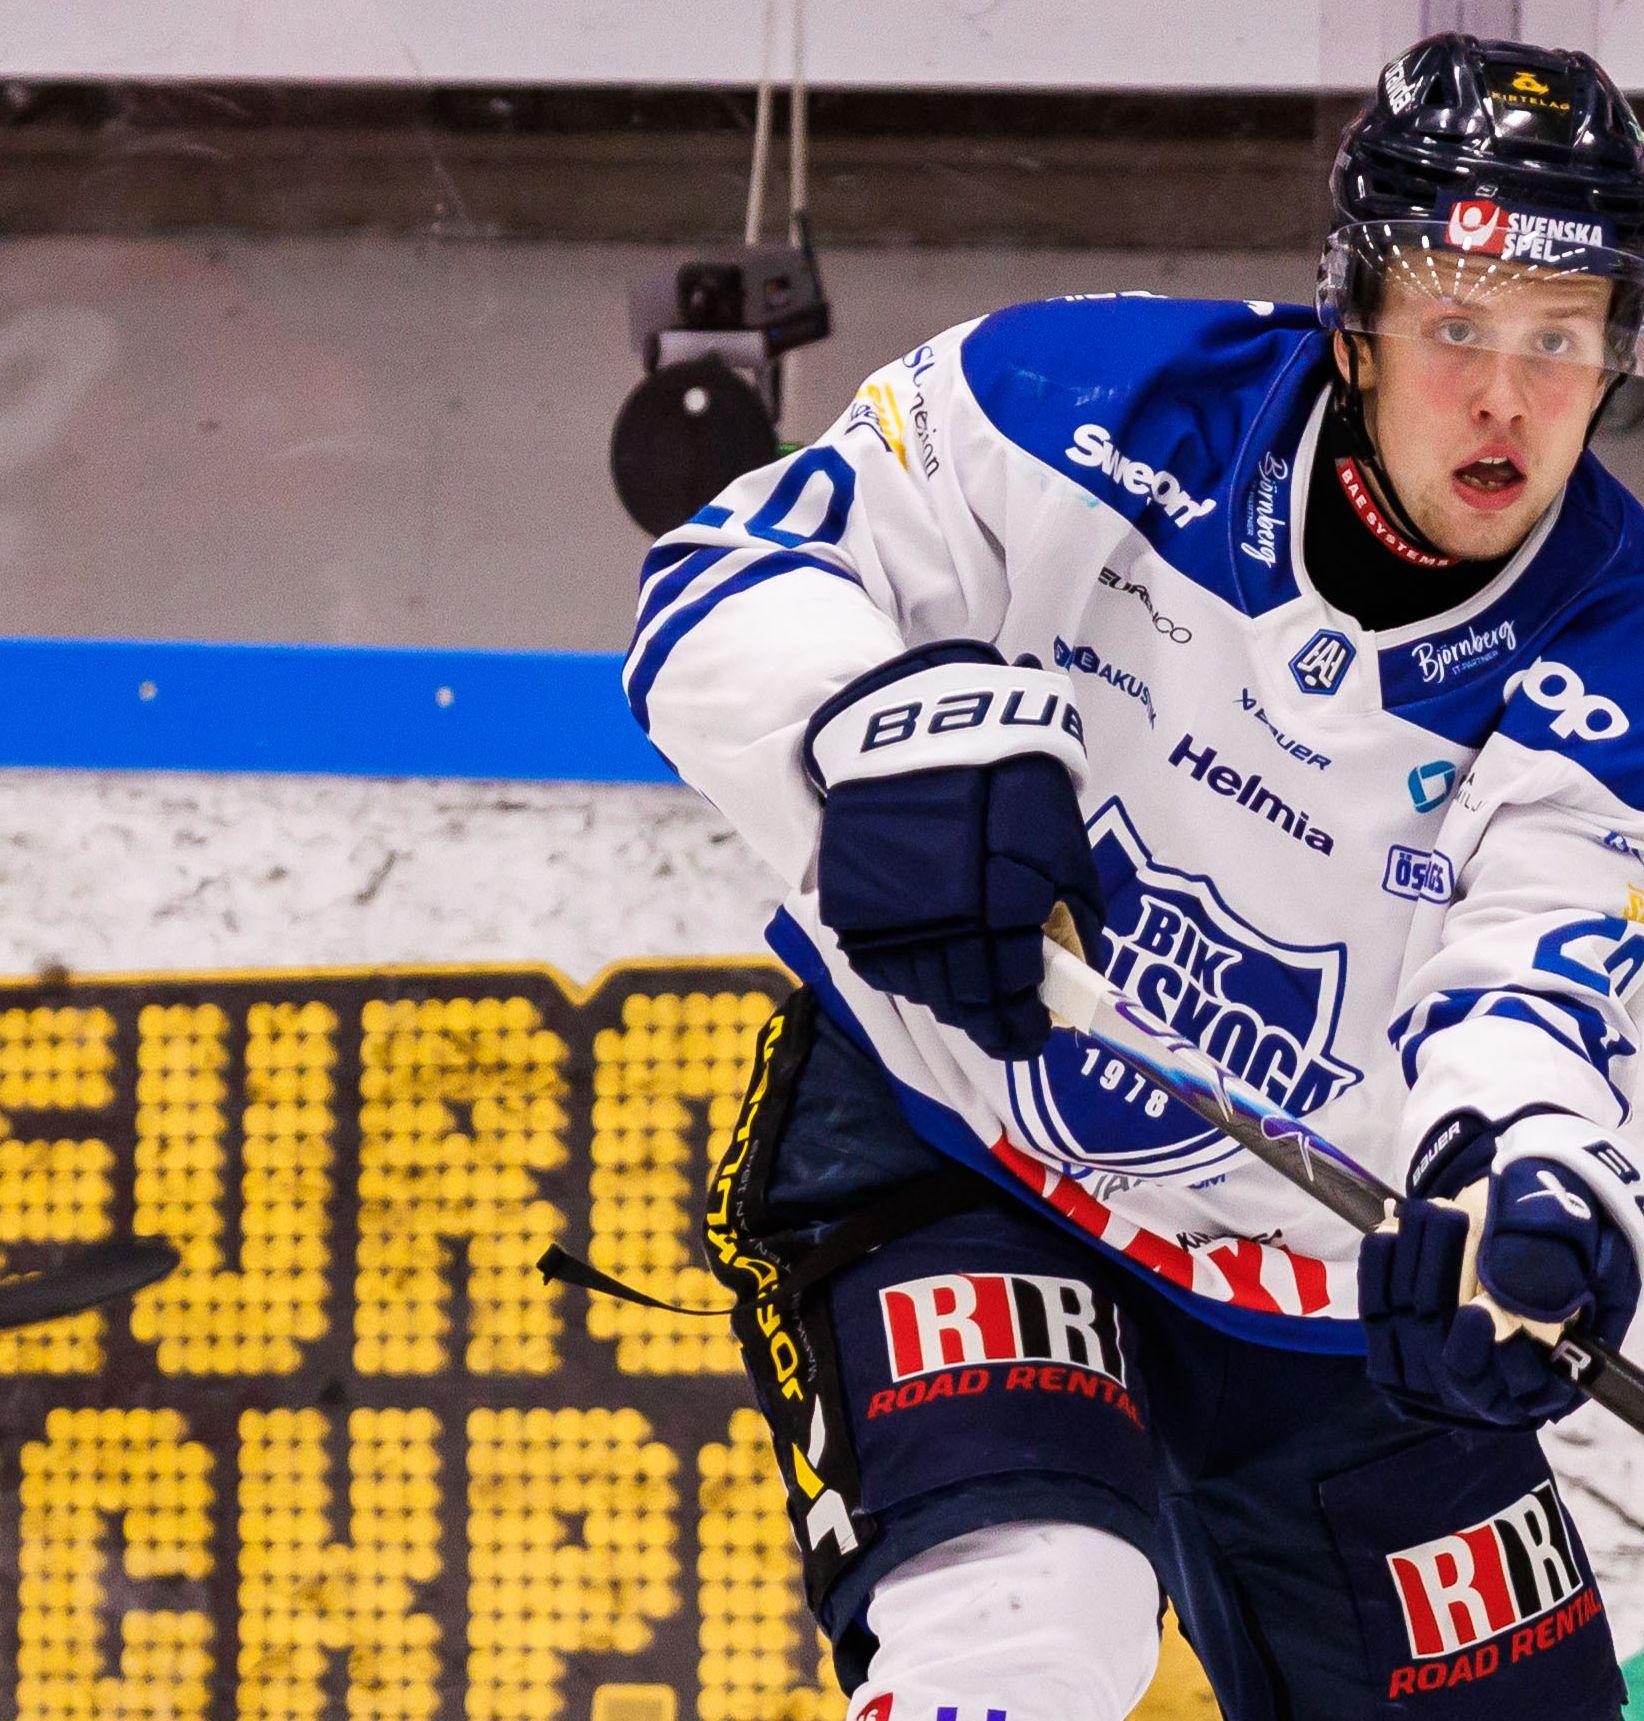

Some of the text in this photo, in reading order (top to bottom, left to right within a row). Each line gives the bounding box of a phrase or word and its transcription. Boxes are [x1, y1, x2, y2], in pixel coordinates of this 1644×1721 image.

[1501, 232, 1561, 262] SPEL
[1507, 212, 1603, 248] SVENSKA
[1241, 450, 1288, 569] Björnberg
[1341, 468, 1449, 566] BAE SYSTEMS
[1411, 620, 1516, 683] Björnberg
[859, 691, 1088, 760] BAUE
[1168, 733, 1334, 856] Helmia
[1134, 898, 1240, 998] BIK
[1081, 1048, 1169, 1118] 1978
[1412, 1120, 1461, 1187] BAUER
[866, 1368, 991, 1420] ROAD
[1388, 1586, 1602, 1700] ROAD RENTAL
